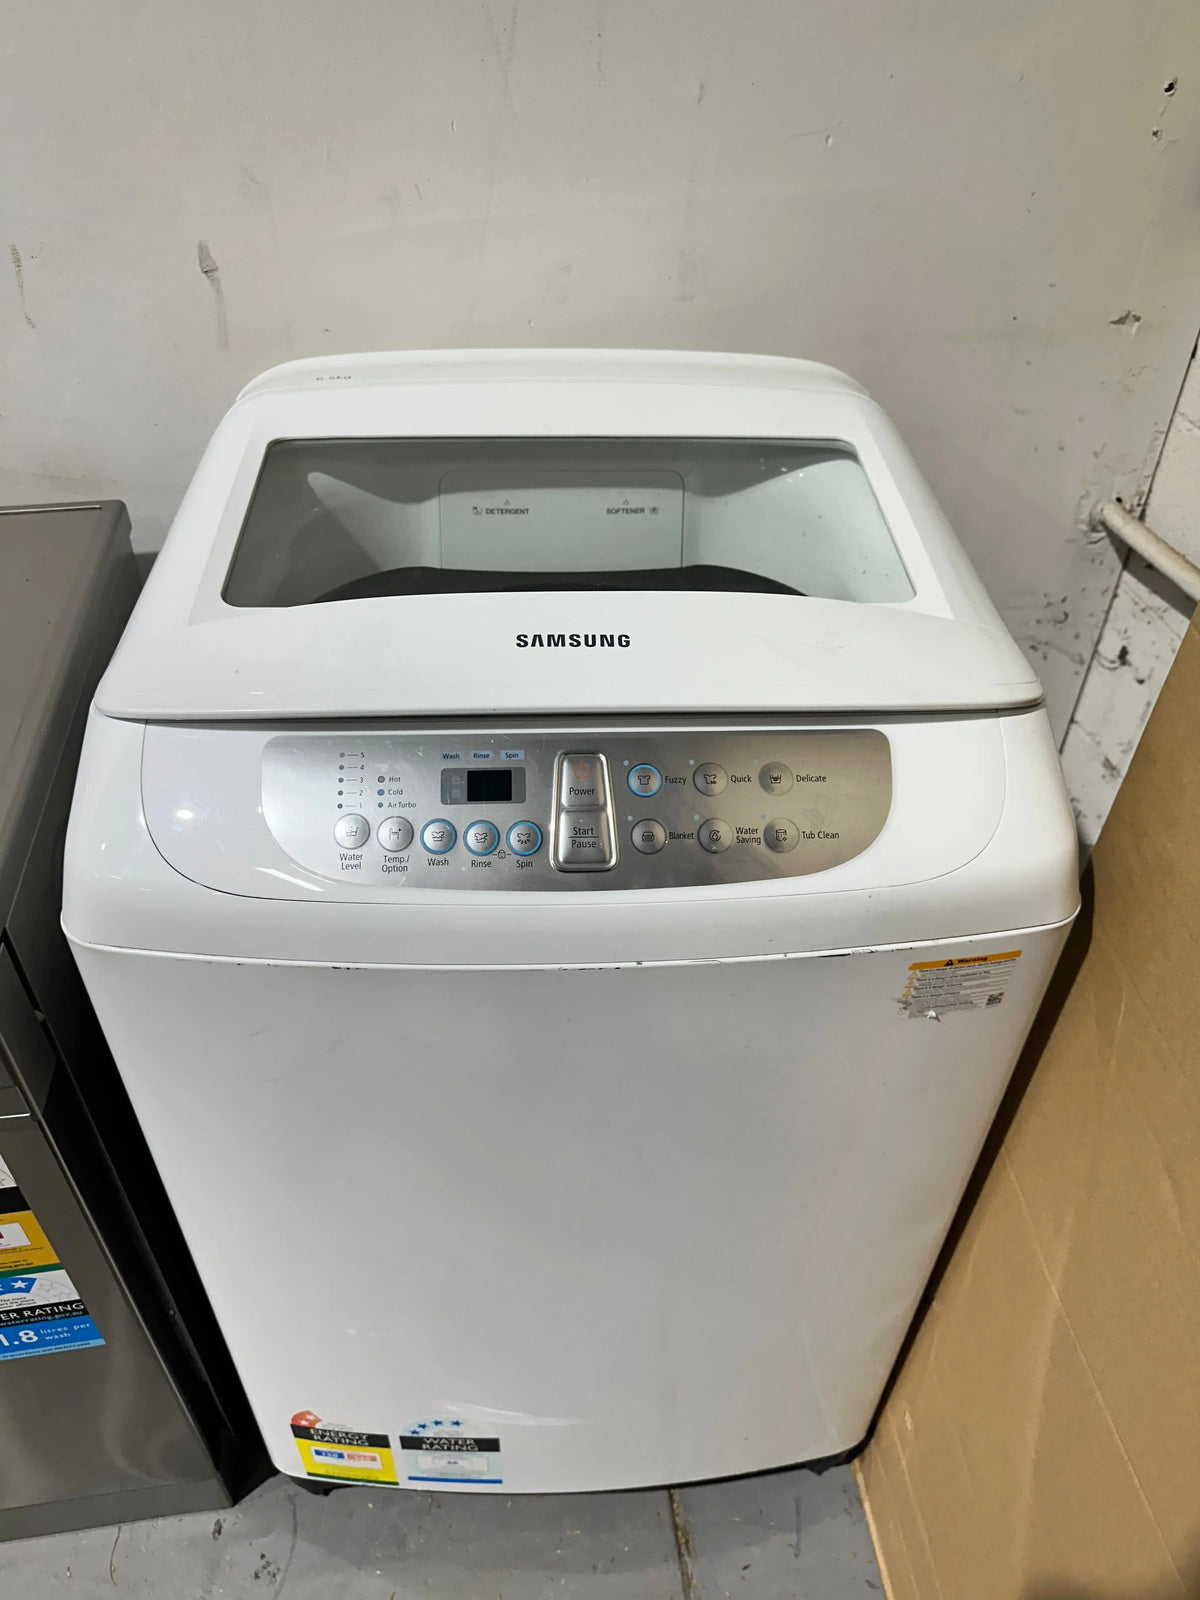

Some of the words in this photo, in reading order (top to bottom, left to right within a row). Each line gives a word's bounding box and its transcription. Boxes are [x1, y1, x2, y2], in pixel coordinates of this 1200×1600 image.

[516, 634, 630, 648] SAMSUNG
[665, 776, 686, 785] Fuzzy
[730, 774, 752, 784] Quick
[569, 787, 595, 795] Power
[573, 826, 594, 835] Start
[818, 831, 839, 839] Clean
[669, 832, 694, 840] Blanket
[736, 836, 761, 845] Saving
[572, 840, 596, 848] Pause
[340, 853, 363, 861] Water
[384, 855, 410, 865] Temp./
[341, 862, 362, 870] Level
[428, 858, 449, 866] Wash
[471, 860, 492, 868] Rinse
[516, 859, 533, 869] Spin
[382, 864, 408, 874] Option
[957, 956, 988, 964] Warning
[23, 1303, 85, 1316] RATING
[310, 1428, 369, 1440] ENERGY
[314, 1435, 369, 1445] RATING
